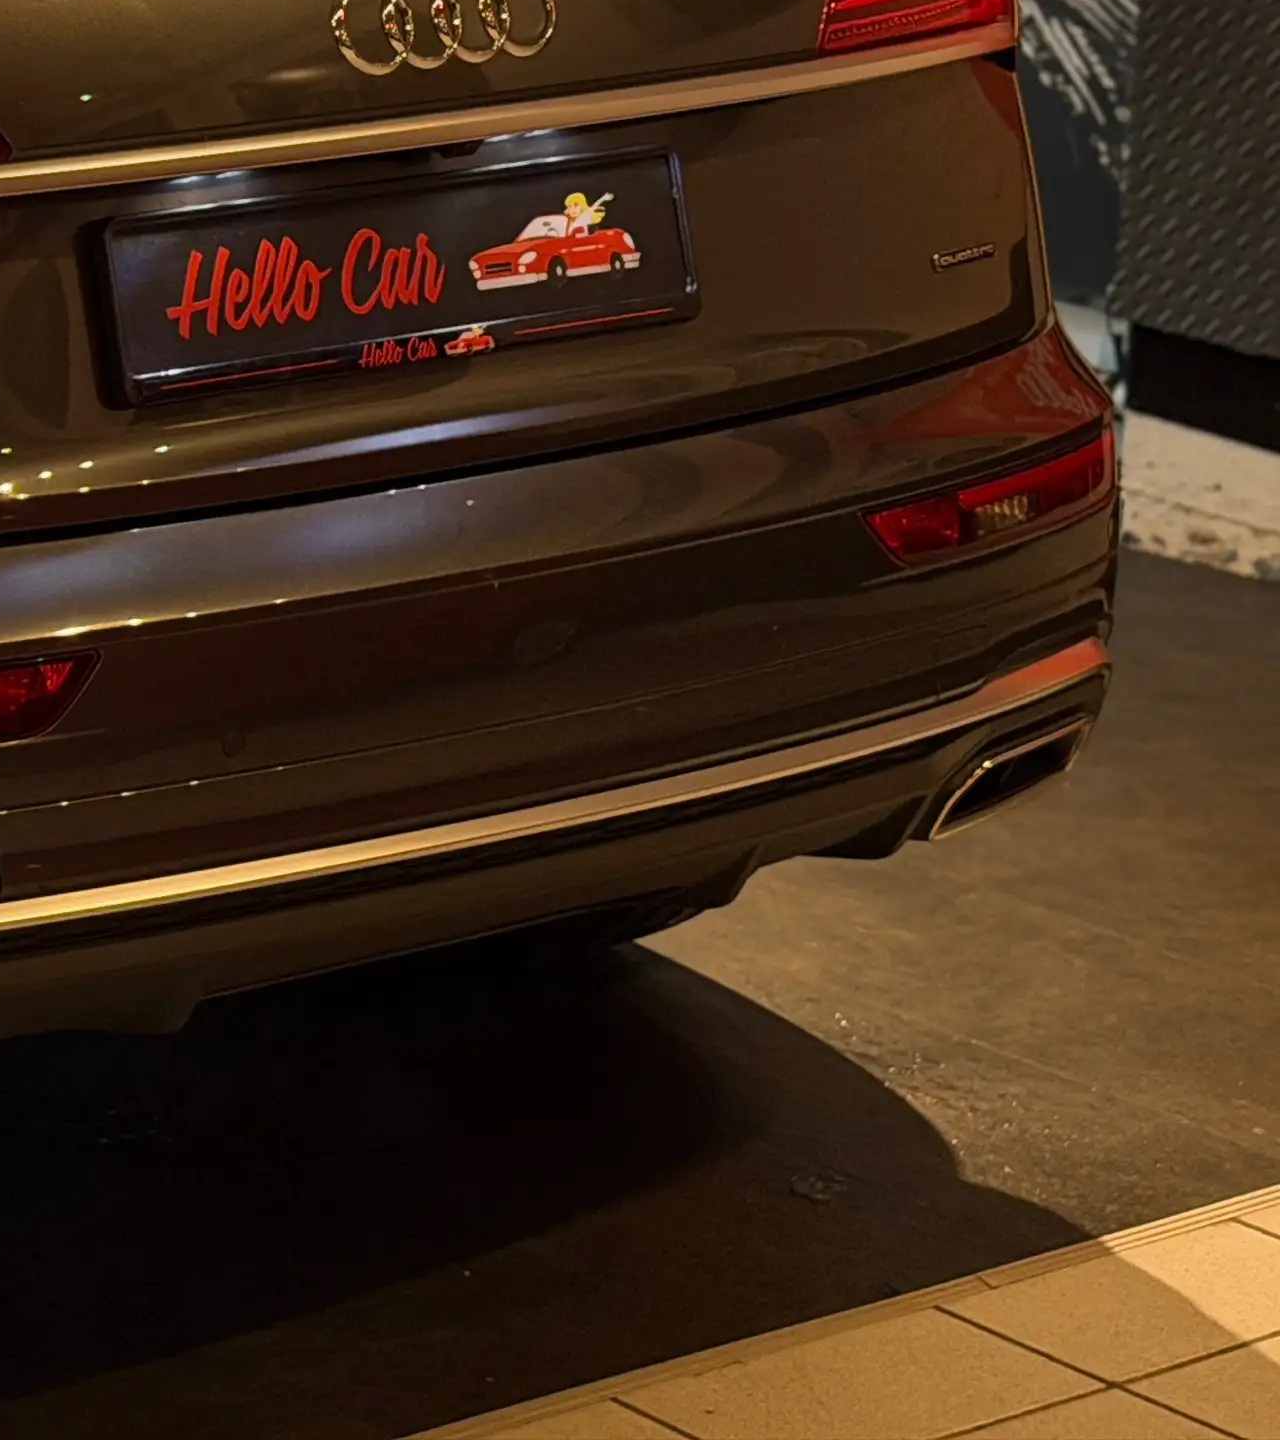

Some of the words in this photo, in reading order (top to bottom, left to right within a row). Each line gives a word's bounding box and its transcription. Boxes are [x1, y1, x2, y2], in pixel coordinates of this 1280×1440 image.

[166, 236, 331, 339] Hello
[341, 228, 447, 315] Car
[358, 339, 404, 368] Hello
[407, 336, 438, 361] Car
